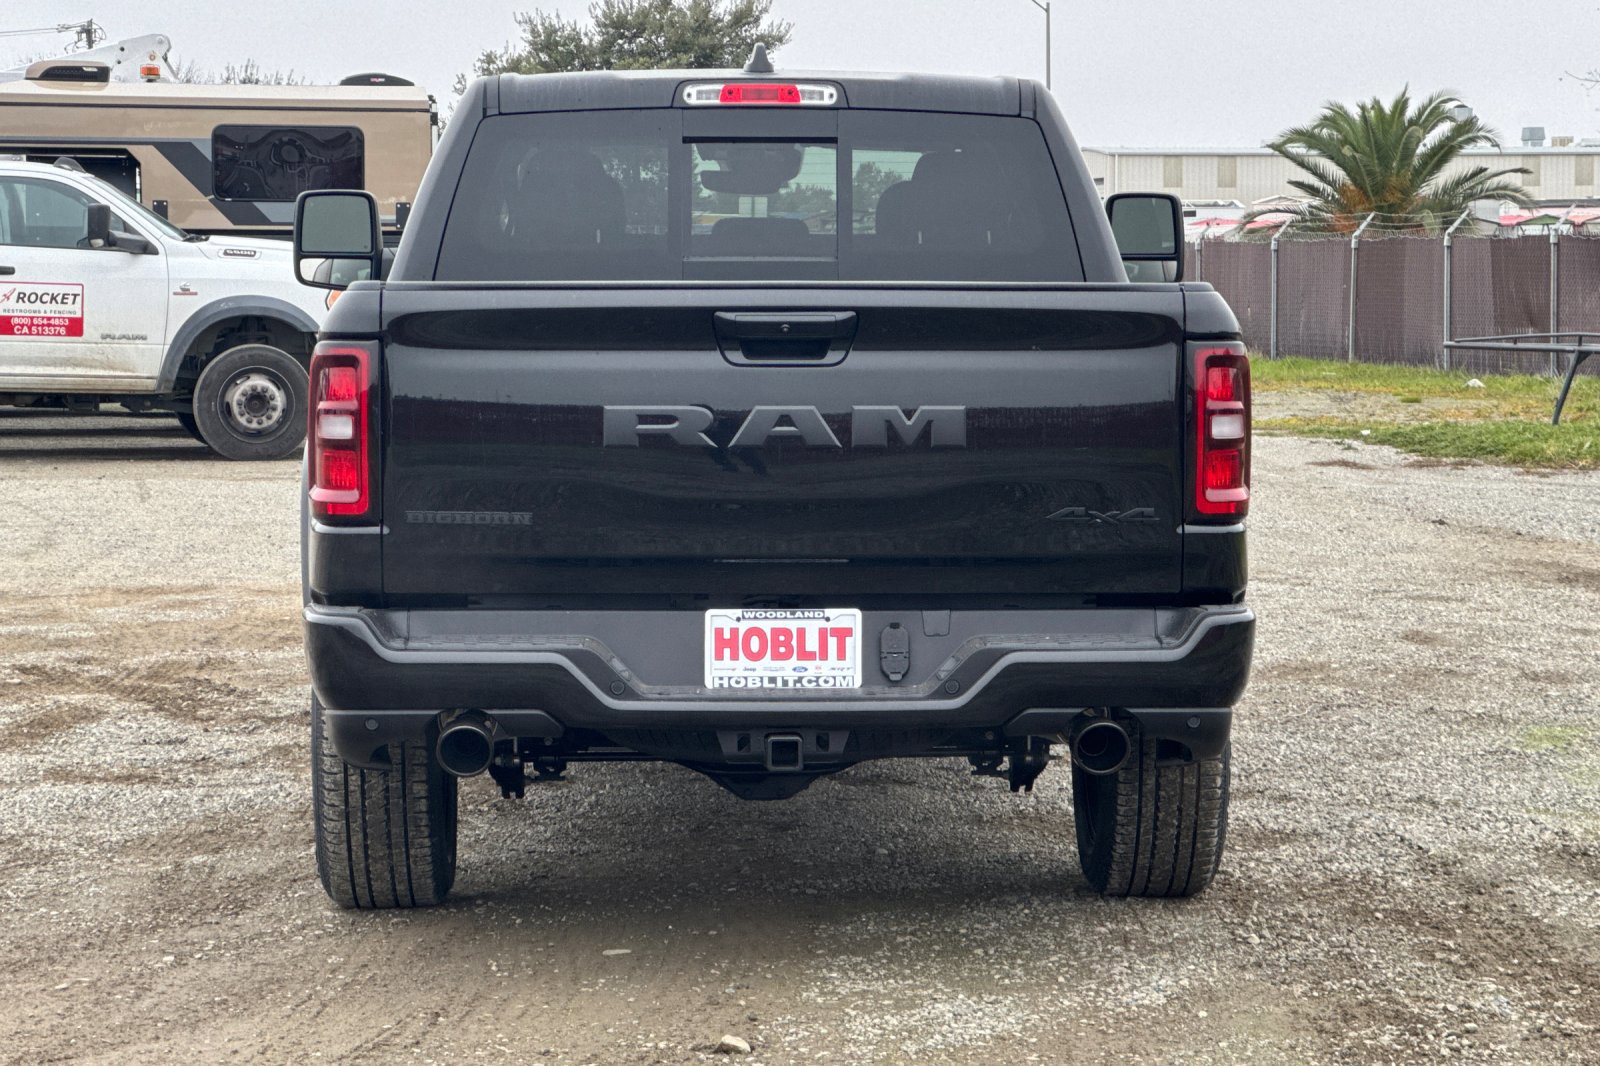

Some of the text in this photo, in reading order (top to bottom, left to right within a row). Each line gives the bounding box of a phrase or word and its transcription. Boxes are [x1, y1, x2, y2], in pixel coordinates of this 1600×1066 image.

[16, 292, 81, 305] ROCKET
[10, 317, 69, 326] (800) 654-4853
[14, 325, 66, 335] CA 513376
[602, 404, 966, 449] RAM
[404, 510, 534, 525] BIGHORN
[743, 611, 824, 619] WOODLAND
[714, 626, 853, 662] HOBLIT
[713, 676, 854, 688] HOBLIT.COM
